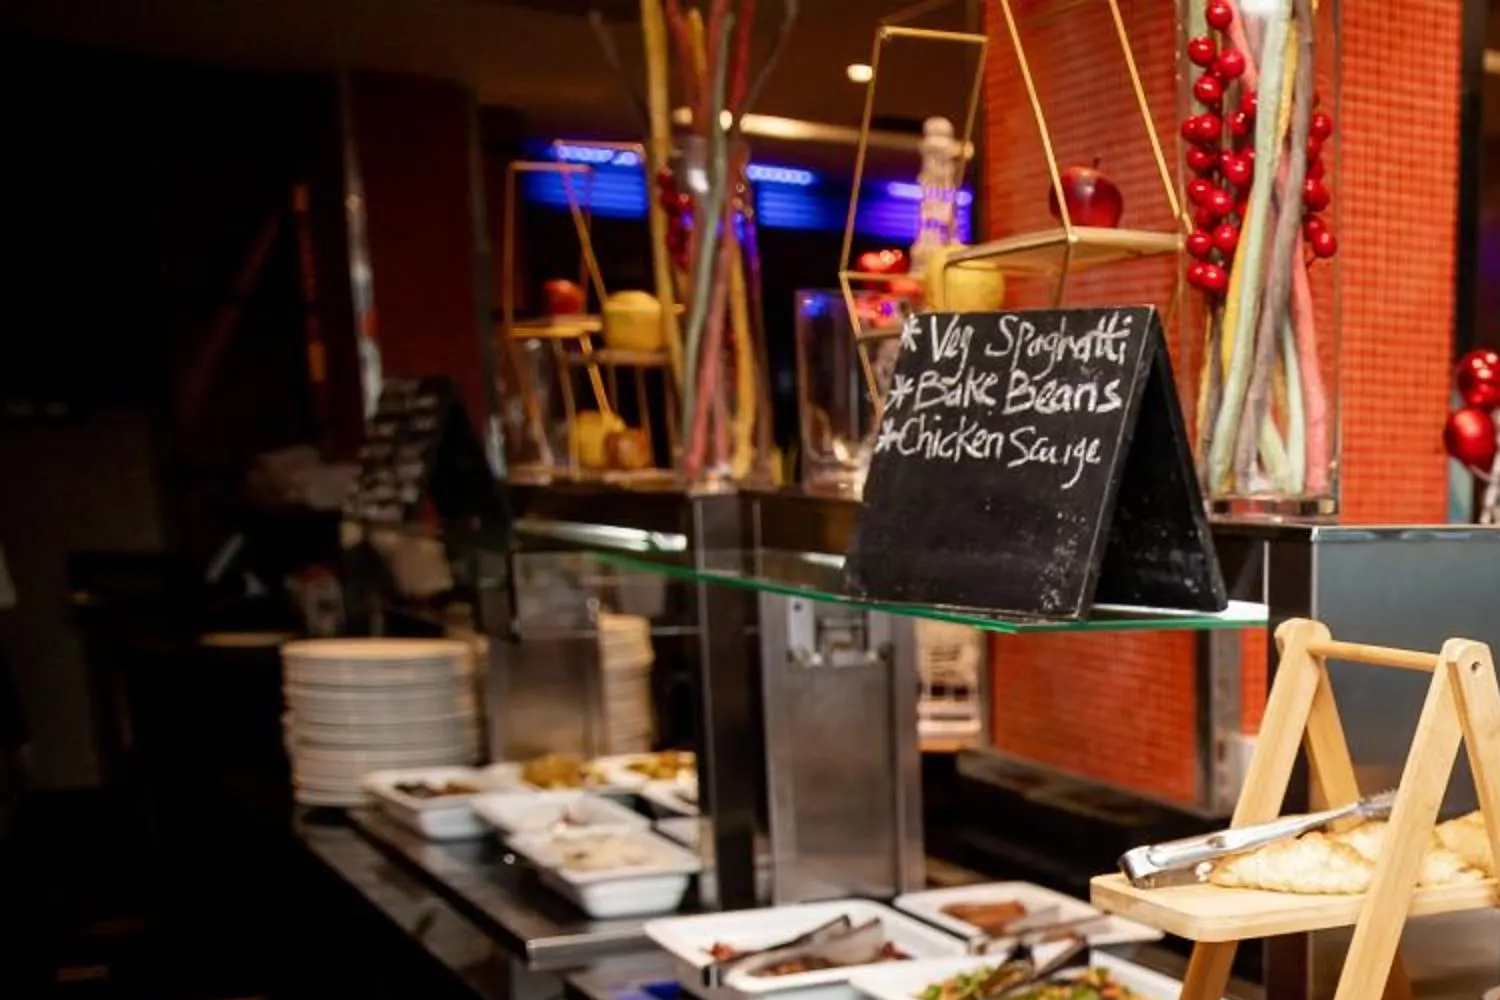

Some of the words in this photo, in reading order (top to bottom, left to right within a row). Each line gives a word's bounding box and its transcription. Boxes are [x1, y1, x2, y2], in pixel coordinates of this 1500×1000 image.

[930, 313, 975, 386] Veg
[913, 367, 999, 412] Bake
[1002, 368, 1122, 415] Beans
[897, 413, 1004, 463] Chicken
